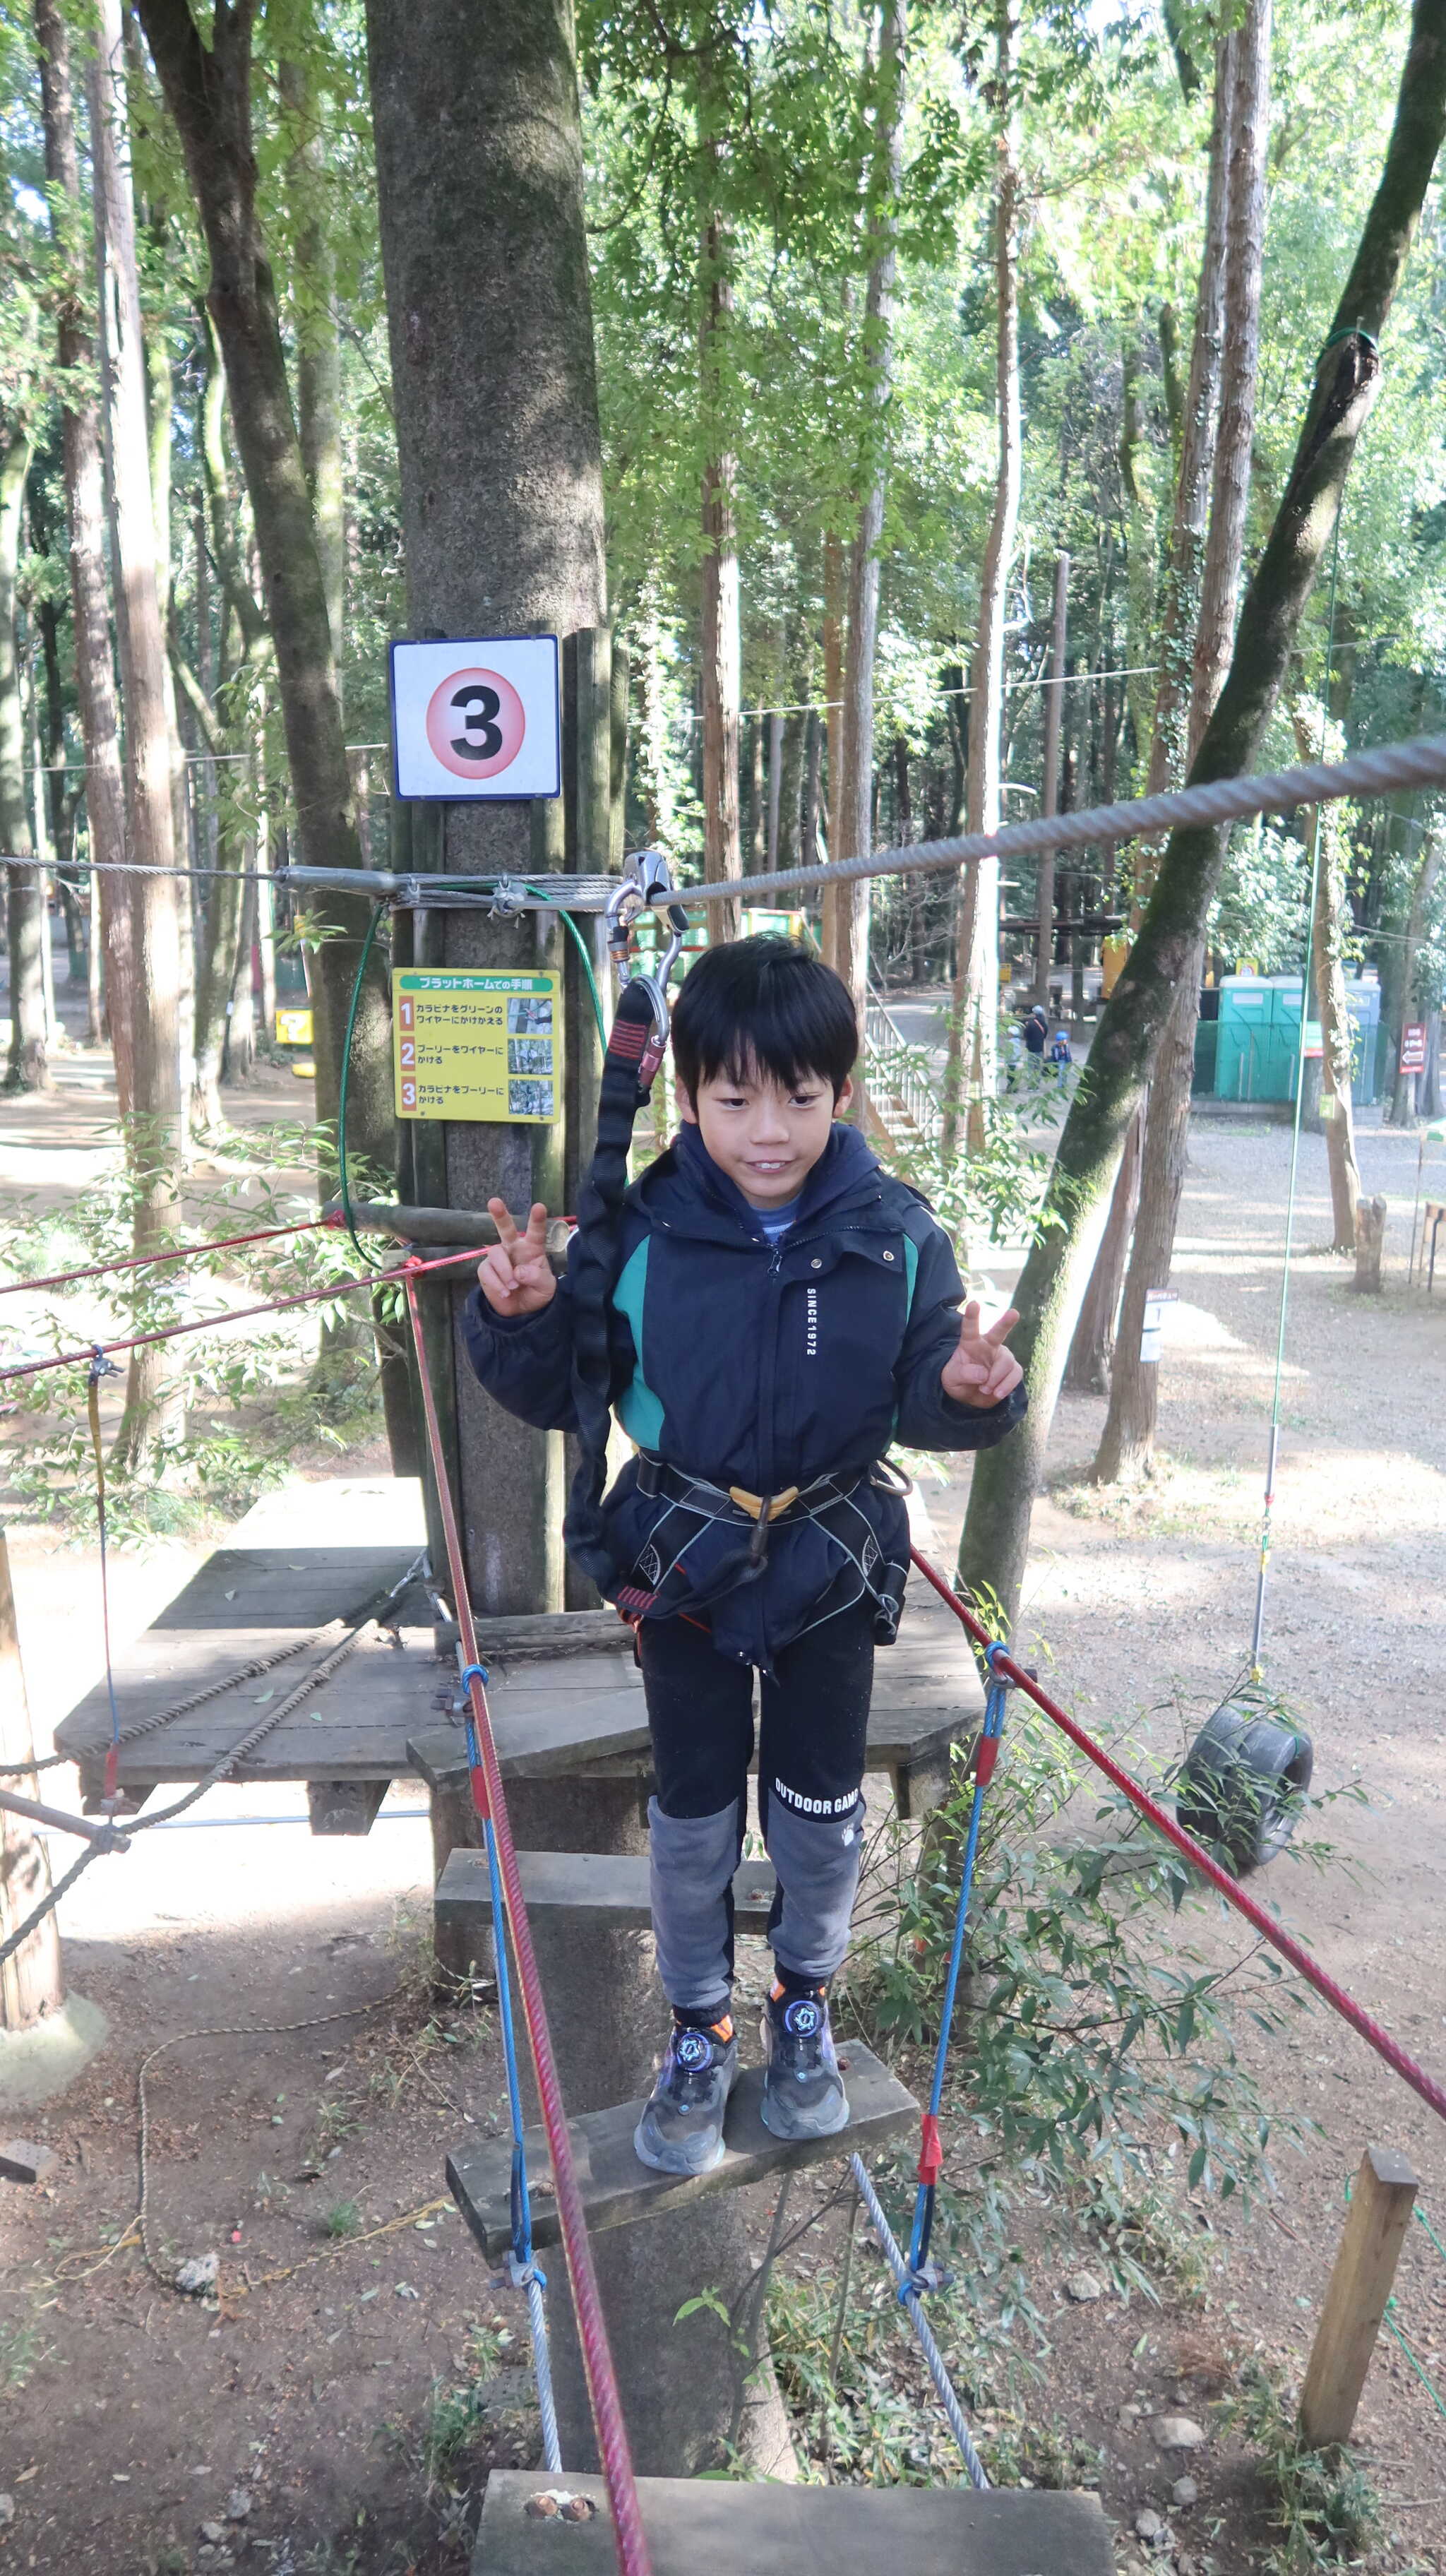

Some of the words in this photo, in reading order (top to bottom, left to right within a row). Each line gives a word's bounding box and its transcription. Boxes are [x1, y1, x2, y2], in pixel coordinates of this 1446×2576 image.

[450, 685, 503, 761] 3
[401, 1003, 411, 1025] 1
[417, 1016, 503, 1025] ワイヤーにかけかえる
[401, 1043, 414, 1064] 2
[418, 1056, 443, 1064] かける
[402, 1083, 415, 1105] 3
[419, 1096, 444, 1104] かける
[775, 1777, 832, 1814] OUTDOOR
